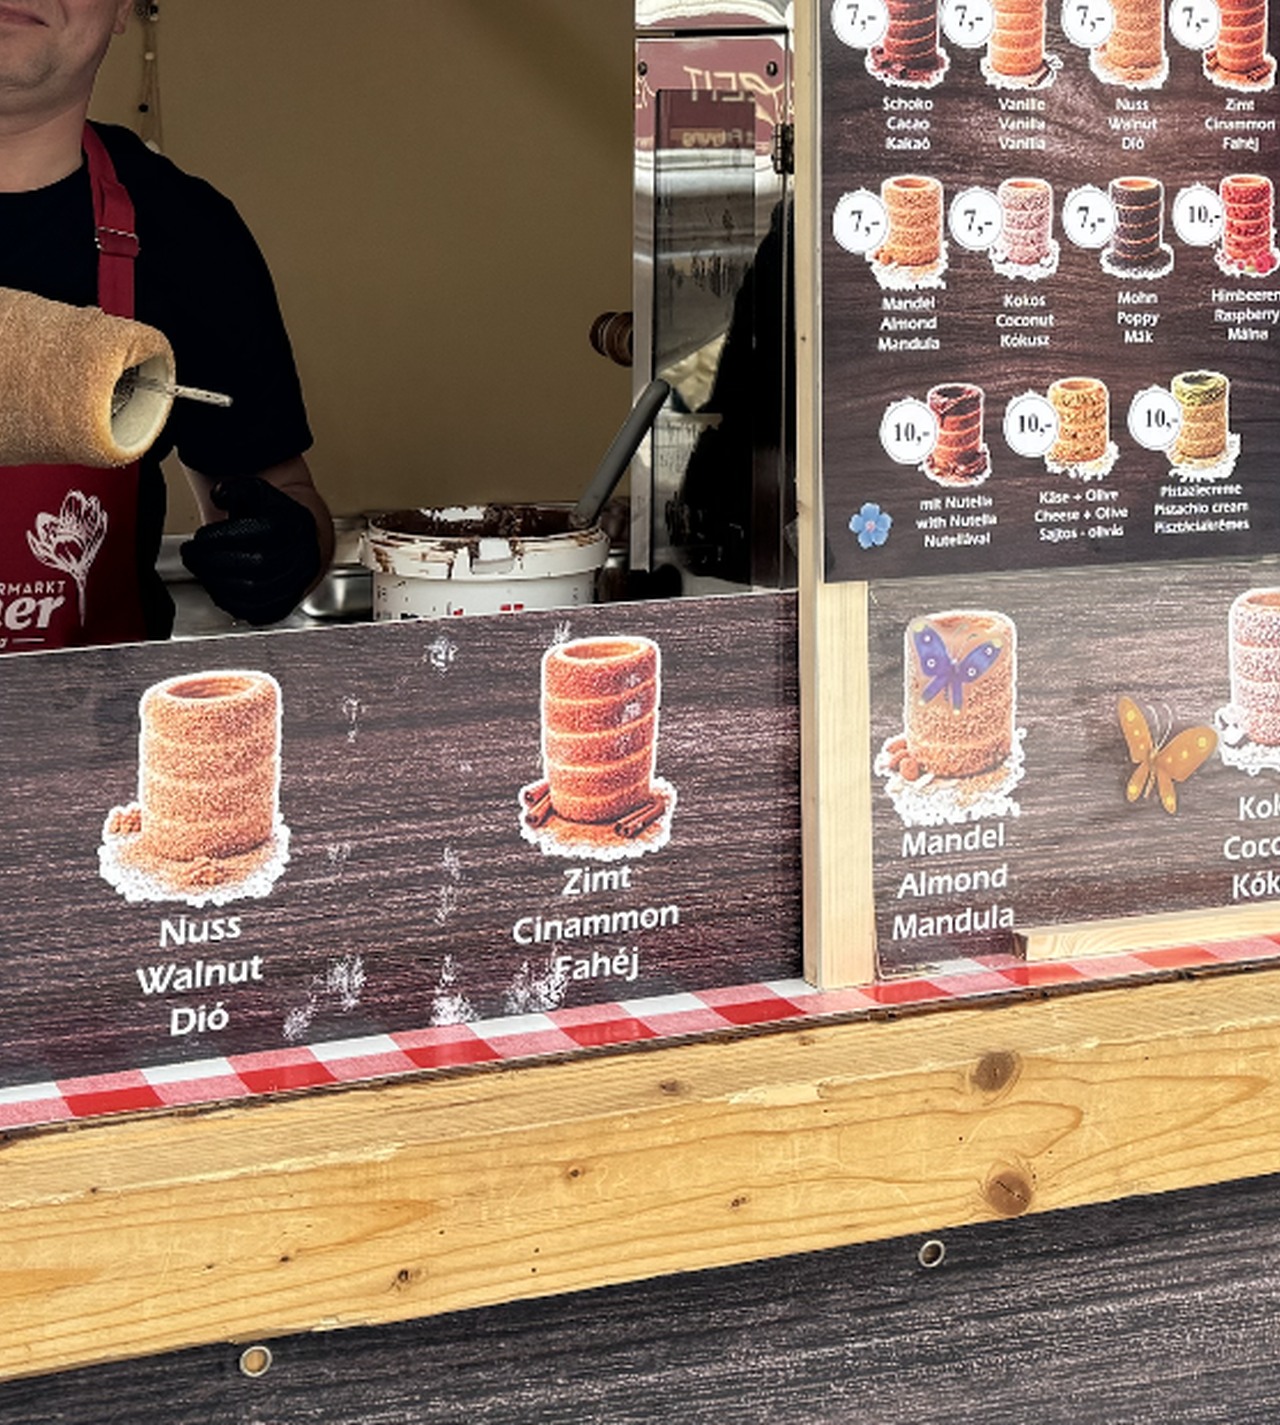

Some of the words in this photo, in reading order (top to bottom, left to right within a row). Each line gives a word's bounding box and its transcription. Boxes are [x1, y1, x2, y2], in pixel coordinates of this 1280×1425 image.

[883, 97, 934, 111] Schoko
[998, 97, 1046, 111] Vanille
[1116, 98, 1149, 111] Nuss
[1225, 98, 1255, 111] Zimt
[886, 116, 930, 131] Cacao
[885, 136, 931, 150] Kakaó
[1122, 136, 1145, 150] Dió
[882, 296, 935, 311] Mandel
[1004, 294, 1046, 308] Kokos
[1118, 291, 1158, 304] Mohn
[879, 316, 937, 331] Almond
[996, 313, 1055, 328] Coconut
[1117, 312, 1160, 328] Poppy
[1214, 308, 1280, 324] Raspberry
[878, 336, 940, 351] Mandula
[1001, 333, 1050, 348] Kókusz
[902, 823, 1006, 860] Mandel
[562, 863, 632, 898] Zimt
[897, 863, 1009, 900] Almond
[513, 902, 680, 946] Cinammon
[892, 902, 1015, 942] Mandula
[159, 914, 241, 948] Nuss
[554, 946, 640, 986] Fahéj
[136, 956, 263, 995] Walnut
[169, 1005, 230, 1039] Dió
